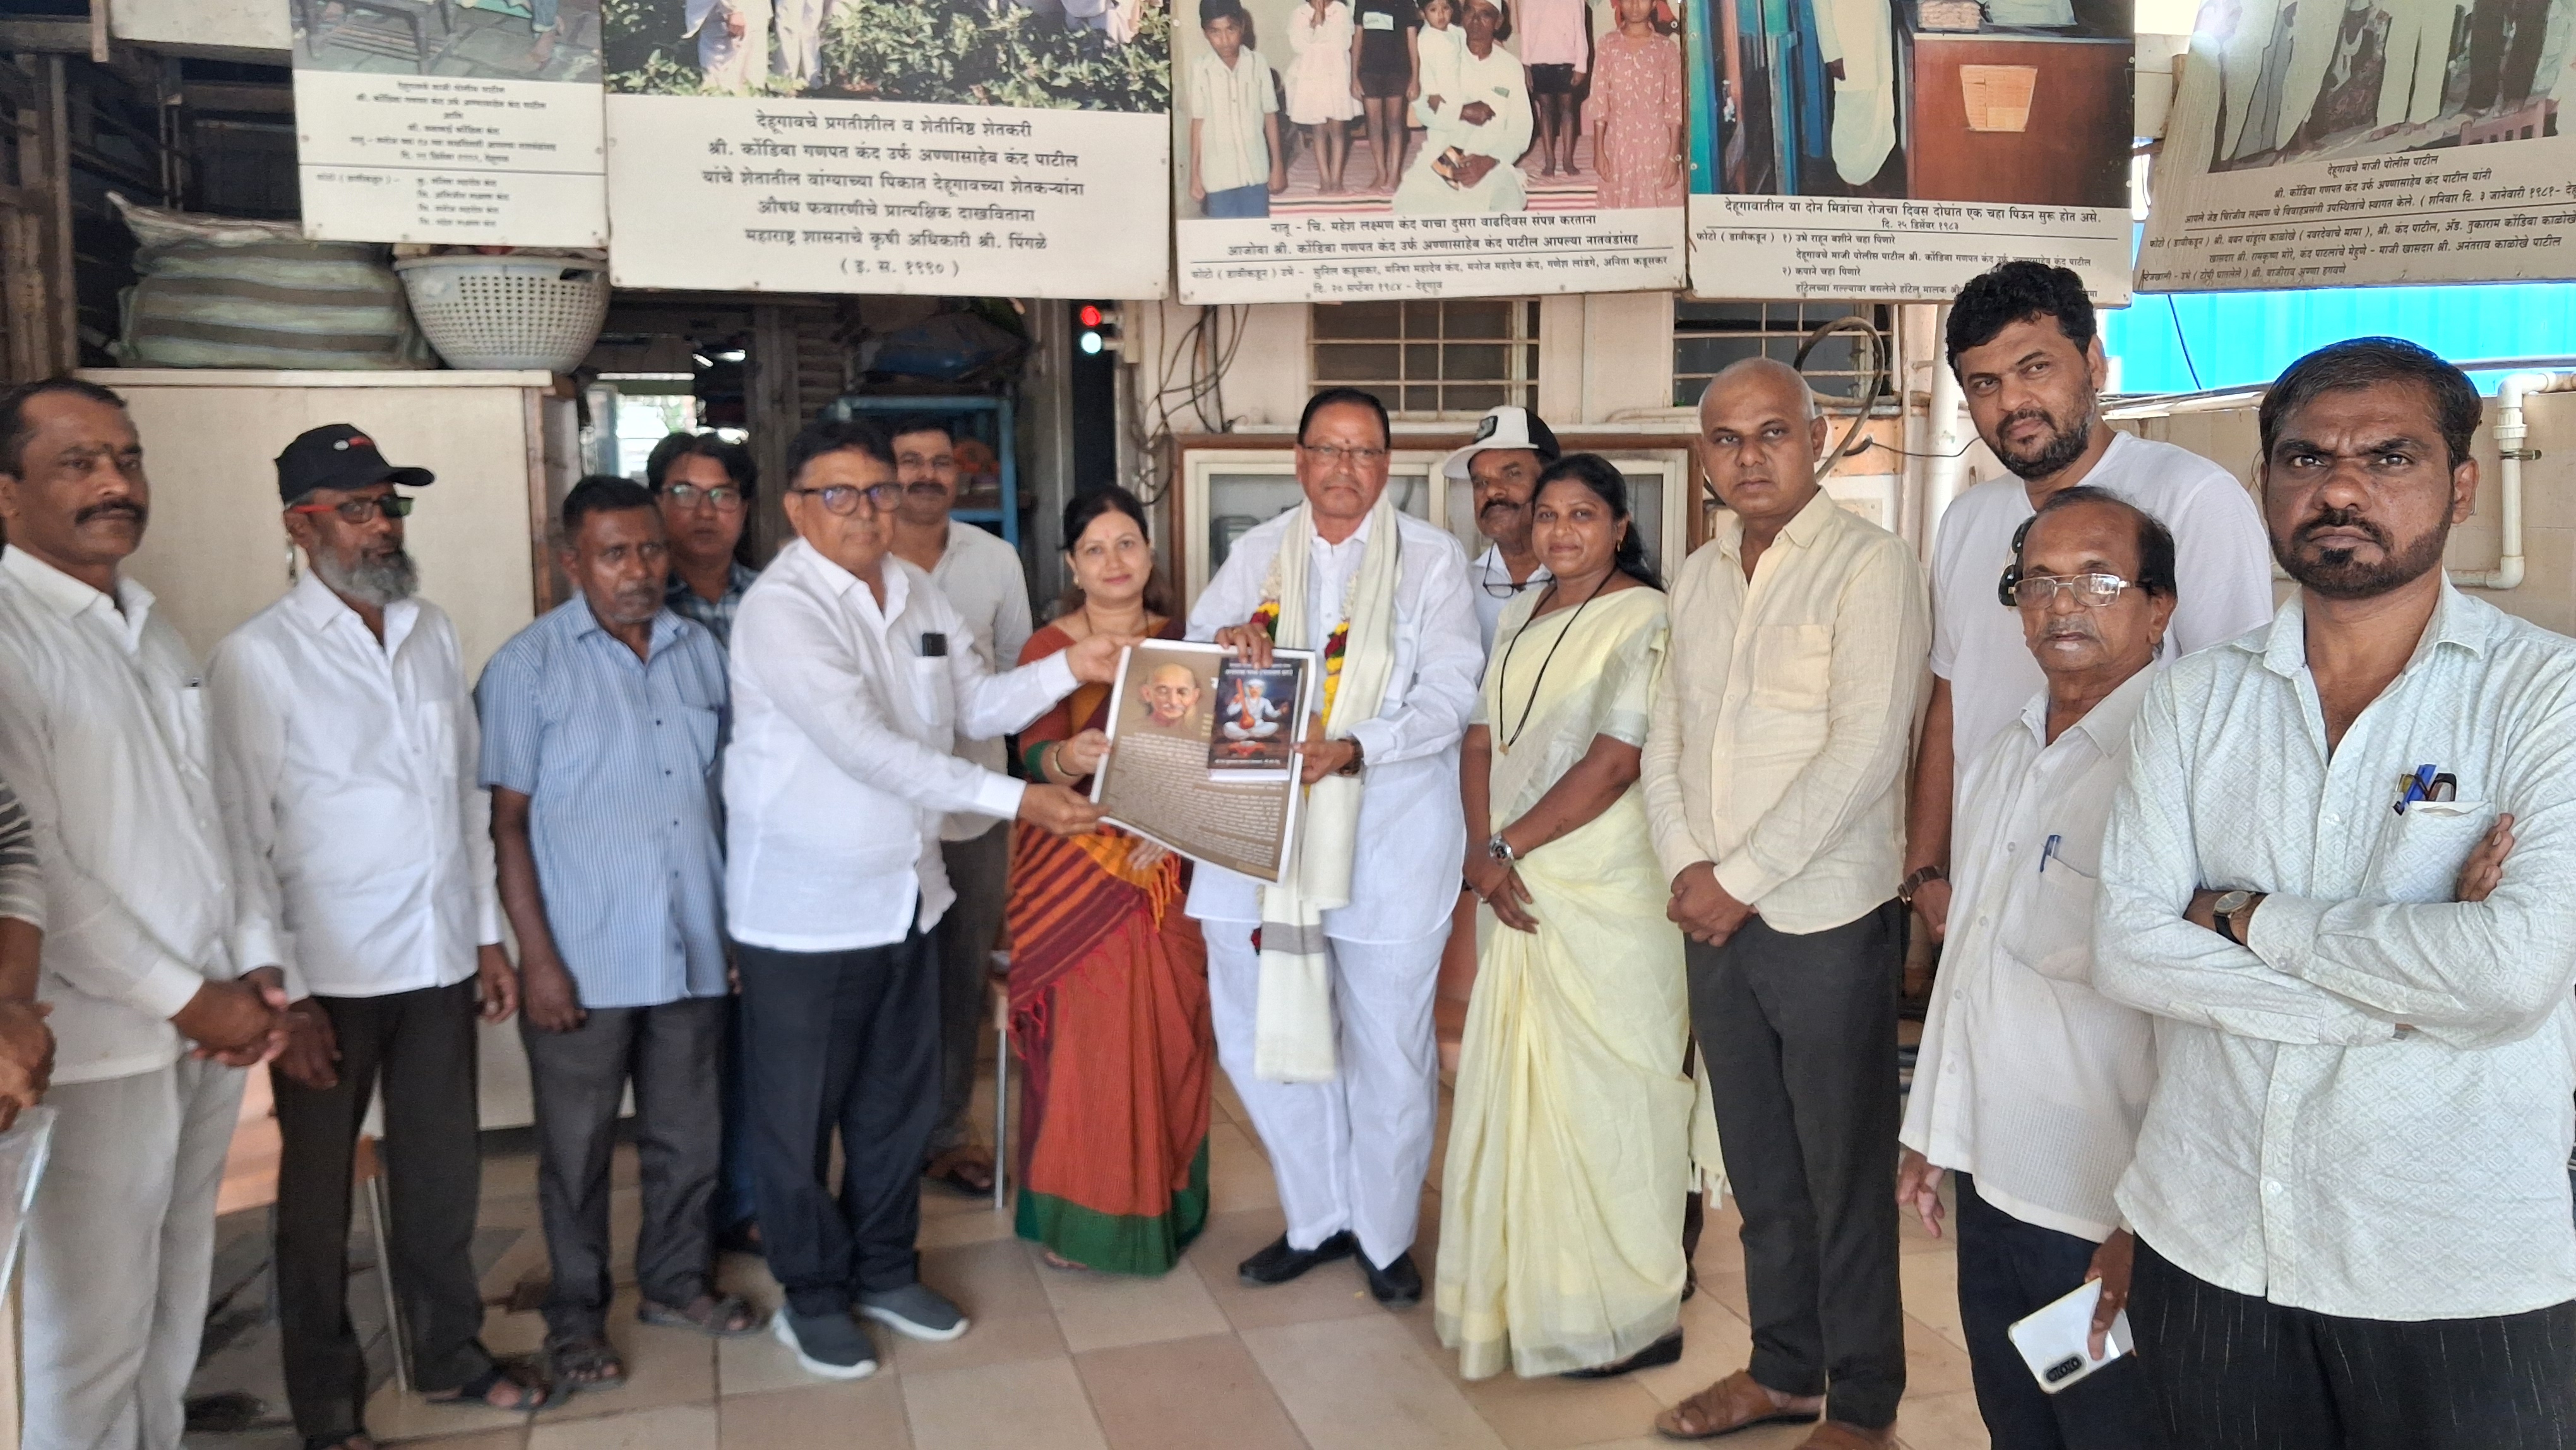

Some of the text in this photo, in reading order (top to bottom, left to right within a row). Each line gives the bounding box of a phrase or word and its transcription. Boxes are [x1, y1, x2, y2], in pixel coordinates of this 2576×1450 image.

[755, 109, 818, 135] देहूगावचे
[824, 113, 896, 132] प्रगतीशील
[981, 117, 1032, 137] शेतकरी
[1034, 150, 1079, 167] पाटील
[2383, 155, 2411, 169] पोलीस
[2412, 153, 2440, 166] पाटील
[2442, 170, 2469, 184] पाटील
[1724, 197, 1784, 215] देहूगावातील
[1788, 202, 1801, 212] या
[1804, 199, 1823, 214] दोन
[1827, 199, 1864, 214] मित्रांचा
[1866, 200, 1899, 216] रोजचा
[1902, 201, 1929, 217] दिवस
[1965, 208, 1983, 221] एक
[1986, 208, 2005, 220] चहा
[2058, 208, 2076, 223] होत
[1558, 214, 1597, 225] करताना
[1506, 234, 1539, 248] पाटील
[2532, 233, 2563, 248] पाटील
